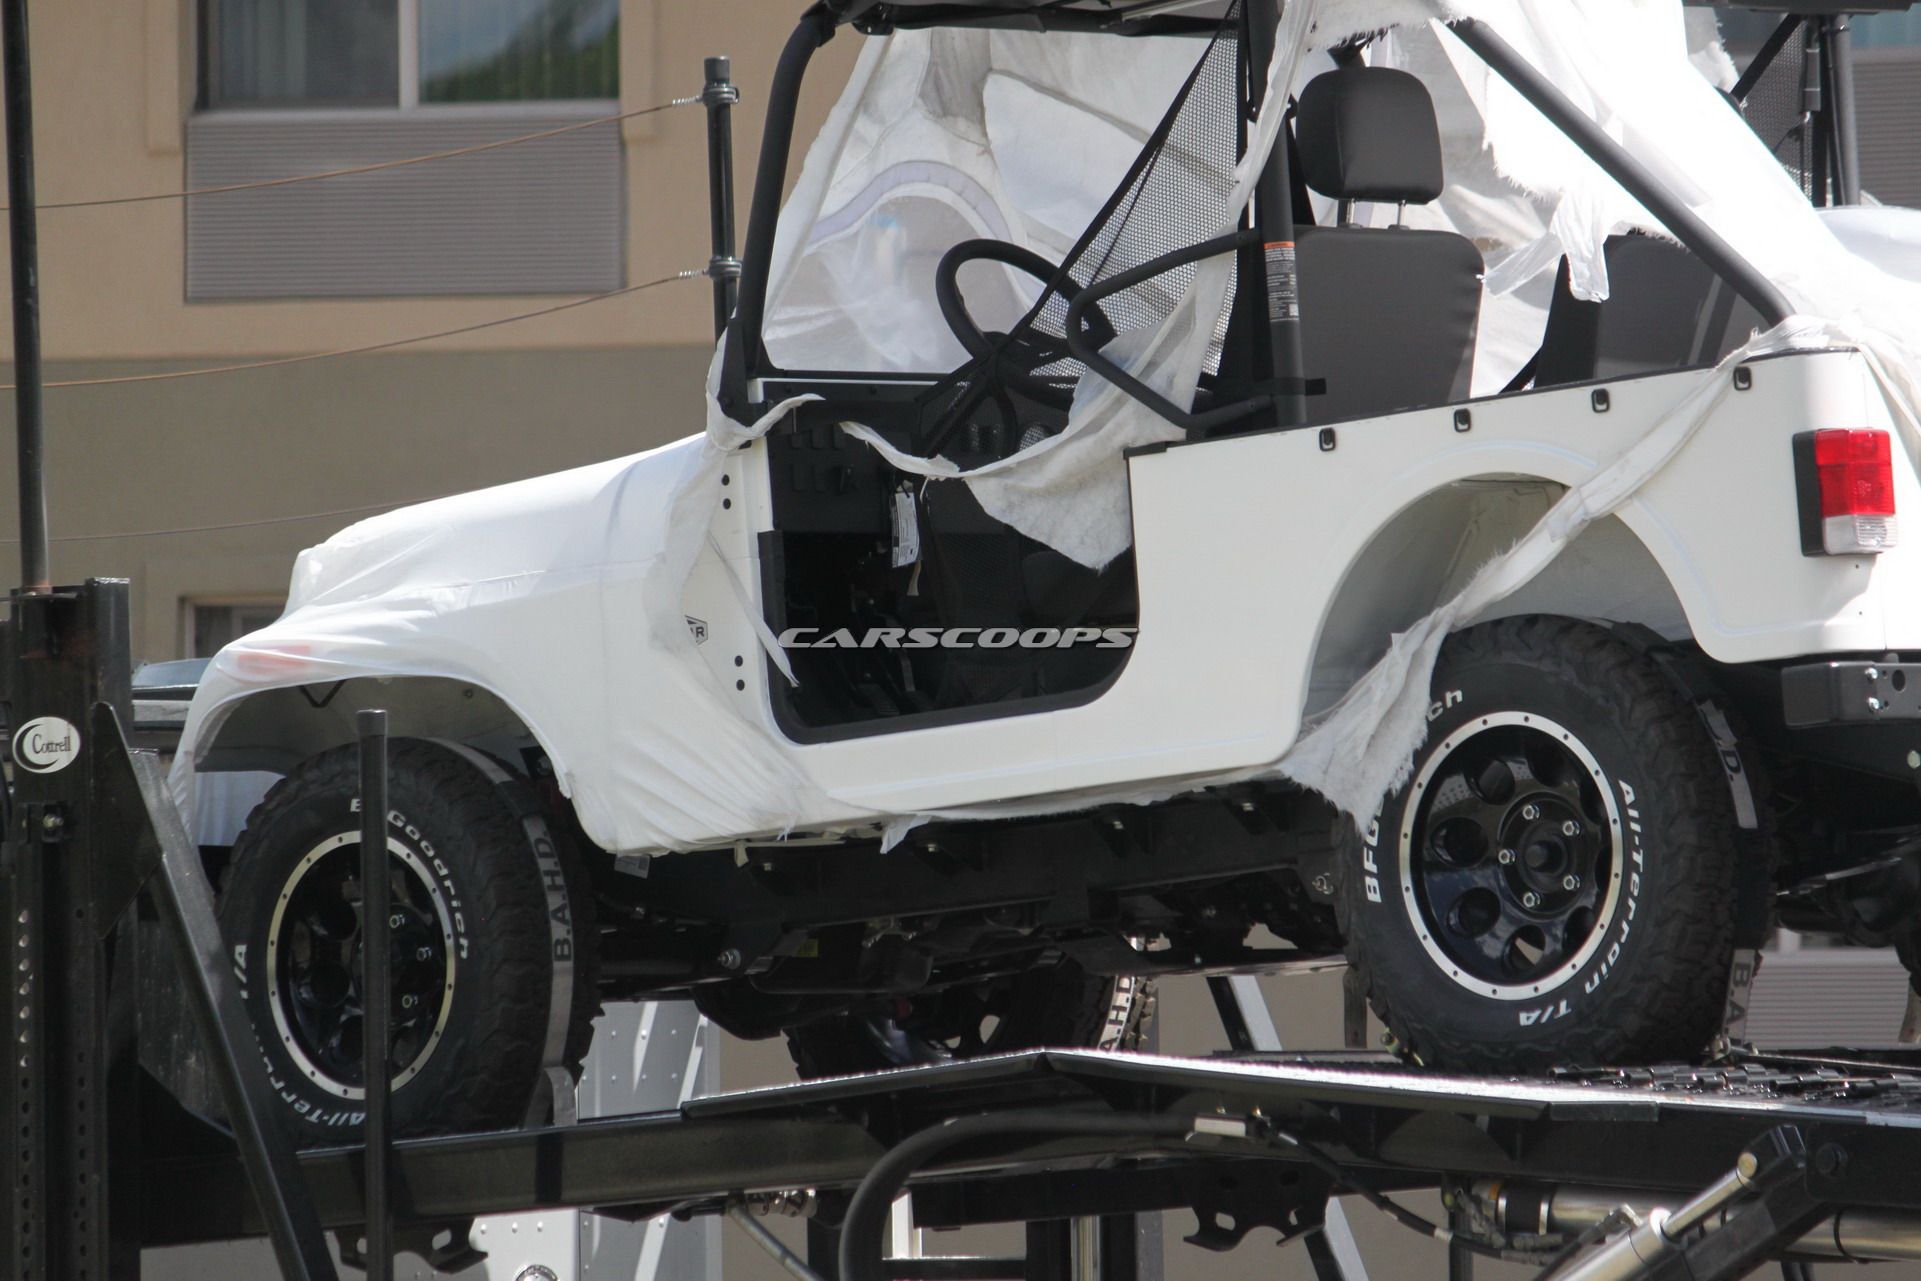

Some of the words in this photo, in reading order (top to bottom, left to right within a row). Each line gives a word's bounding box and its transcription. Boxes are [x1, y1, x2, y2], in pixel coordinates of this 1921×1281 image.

[32, 733, 72, 755] Cottrell
[350, 798, 469, 960] BGoodrich
[1584, 779, 1644, 995] All-Terrain
[1518, 999, 1572, 1027] T/A
